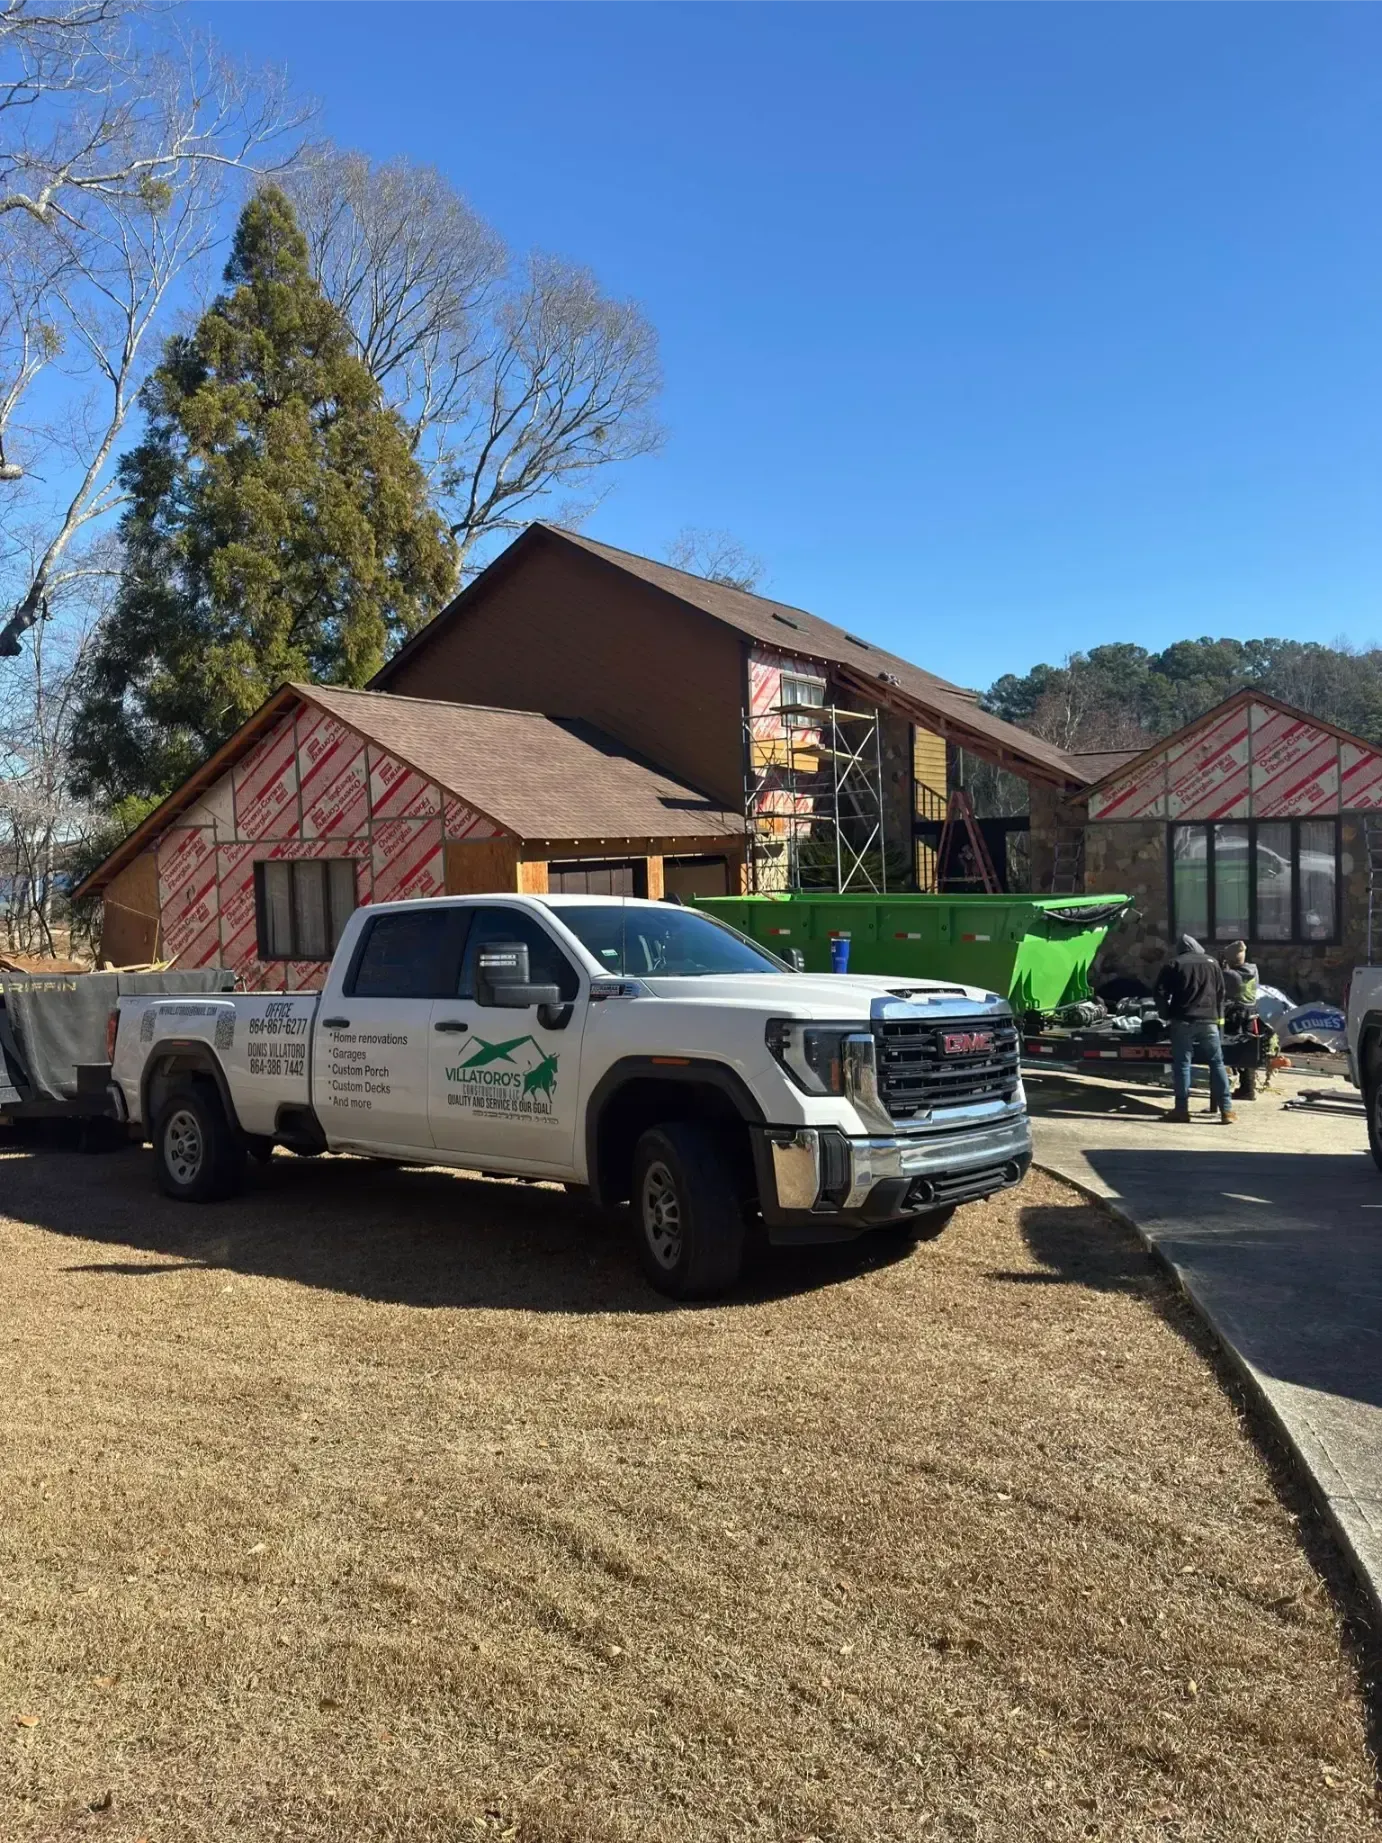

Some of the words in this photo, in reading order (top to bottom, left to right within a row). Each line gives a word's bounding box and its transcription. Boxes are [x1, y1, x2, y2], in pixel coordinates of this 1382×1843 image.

[383, 826, 413, 856] Fiberglas
[265, 1003, 294, 1018] OFFICE
[249, 1018, 308, 1035] 864-867-6277
[333, 1032, 357, 1043] Home
[358, 1034, 408, 1045] renovations
[944, 1033, 995, 1054] GMC
[248, 1042, 267, 1057] DONIS
[269, 1043, 305, 1058] VILLATORO
[333, 1048, 366, 1062] Garages
[284, 1060, 304, 1076] 7442
[332, 1063, 363, 1076] Custom
[365, 1065, 389, 1077] Porch
[445, 1067, 521, 1087] VILLATORO'S
[332, 1080, 363, 1092] Custom
[365, 1081, 391, 1094] Decks
[463, 1084, 507, 1099] CONSTRUCTION
[509, 1087, 520, 1100] LLC
[333, 1096, 349, 1107] And
[351, 1099, 372, 1109] more
[447, 1094, 471, 1107] QUALITY
[472, 1097, 485, 1108] AND
[486, 1098, 511, 1111] SERVICE
[519, 1101, 532, 1113] OUR
